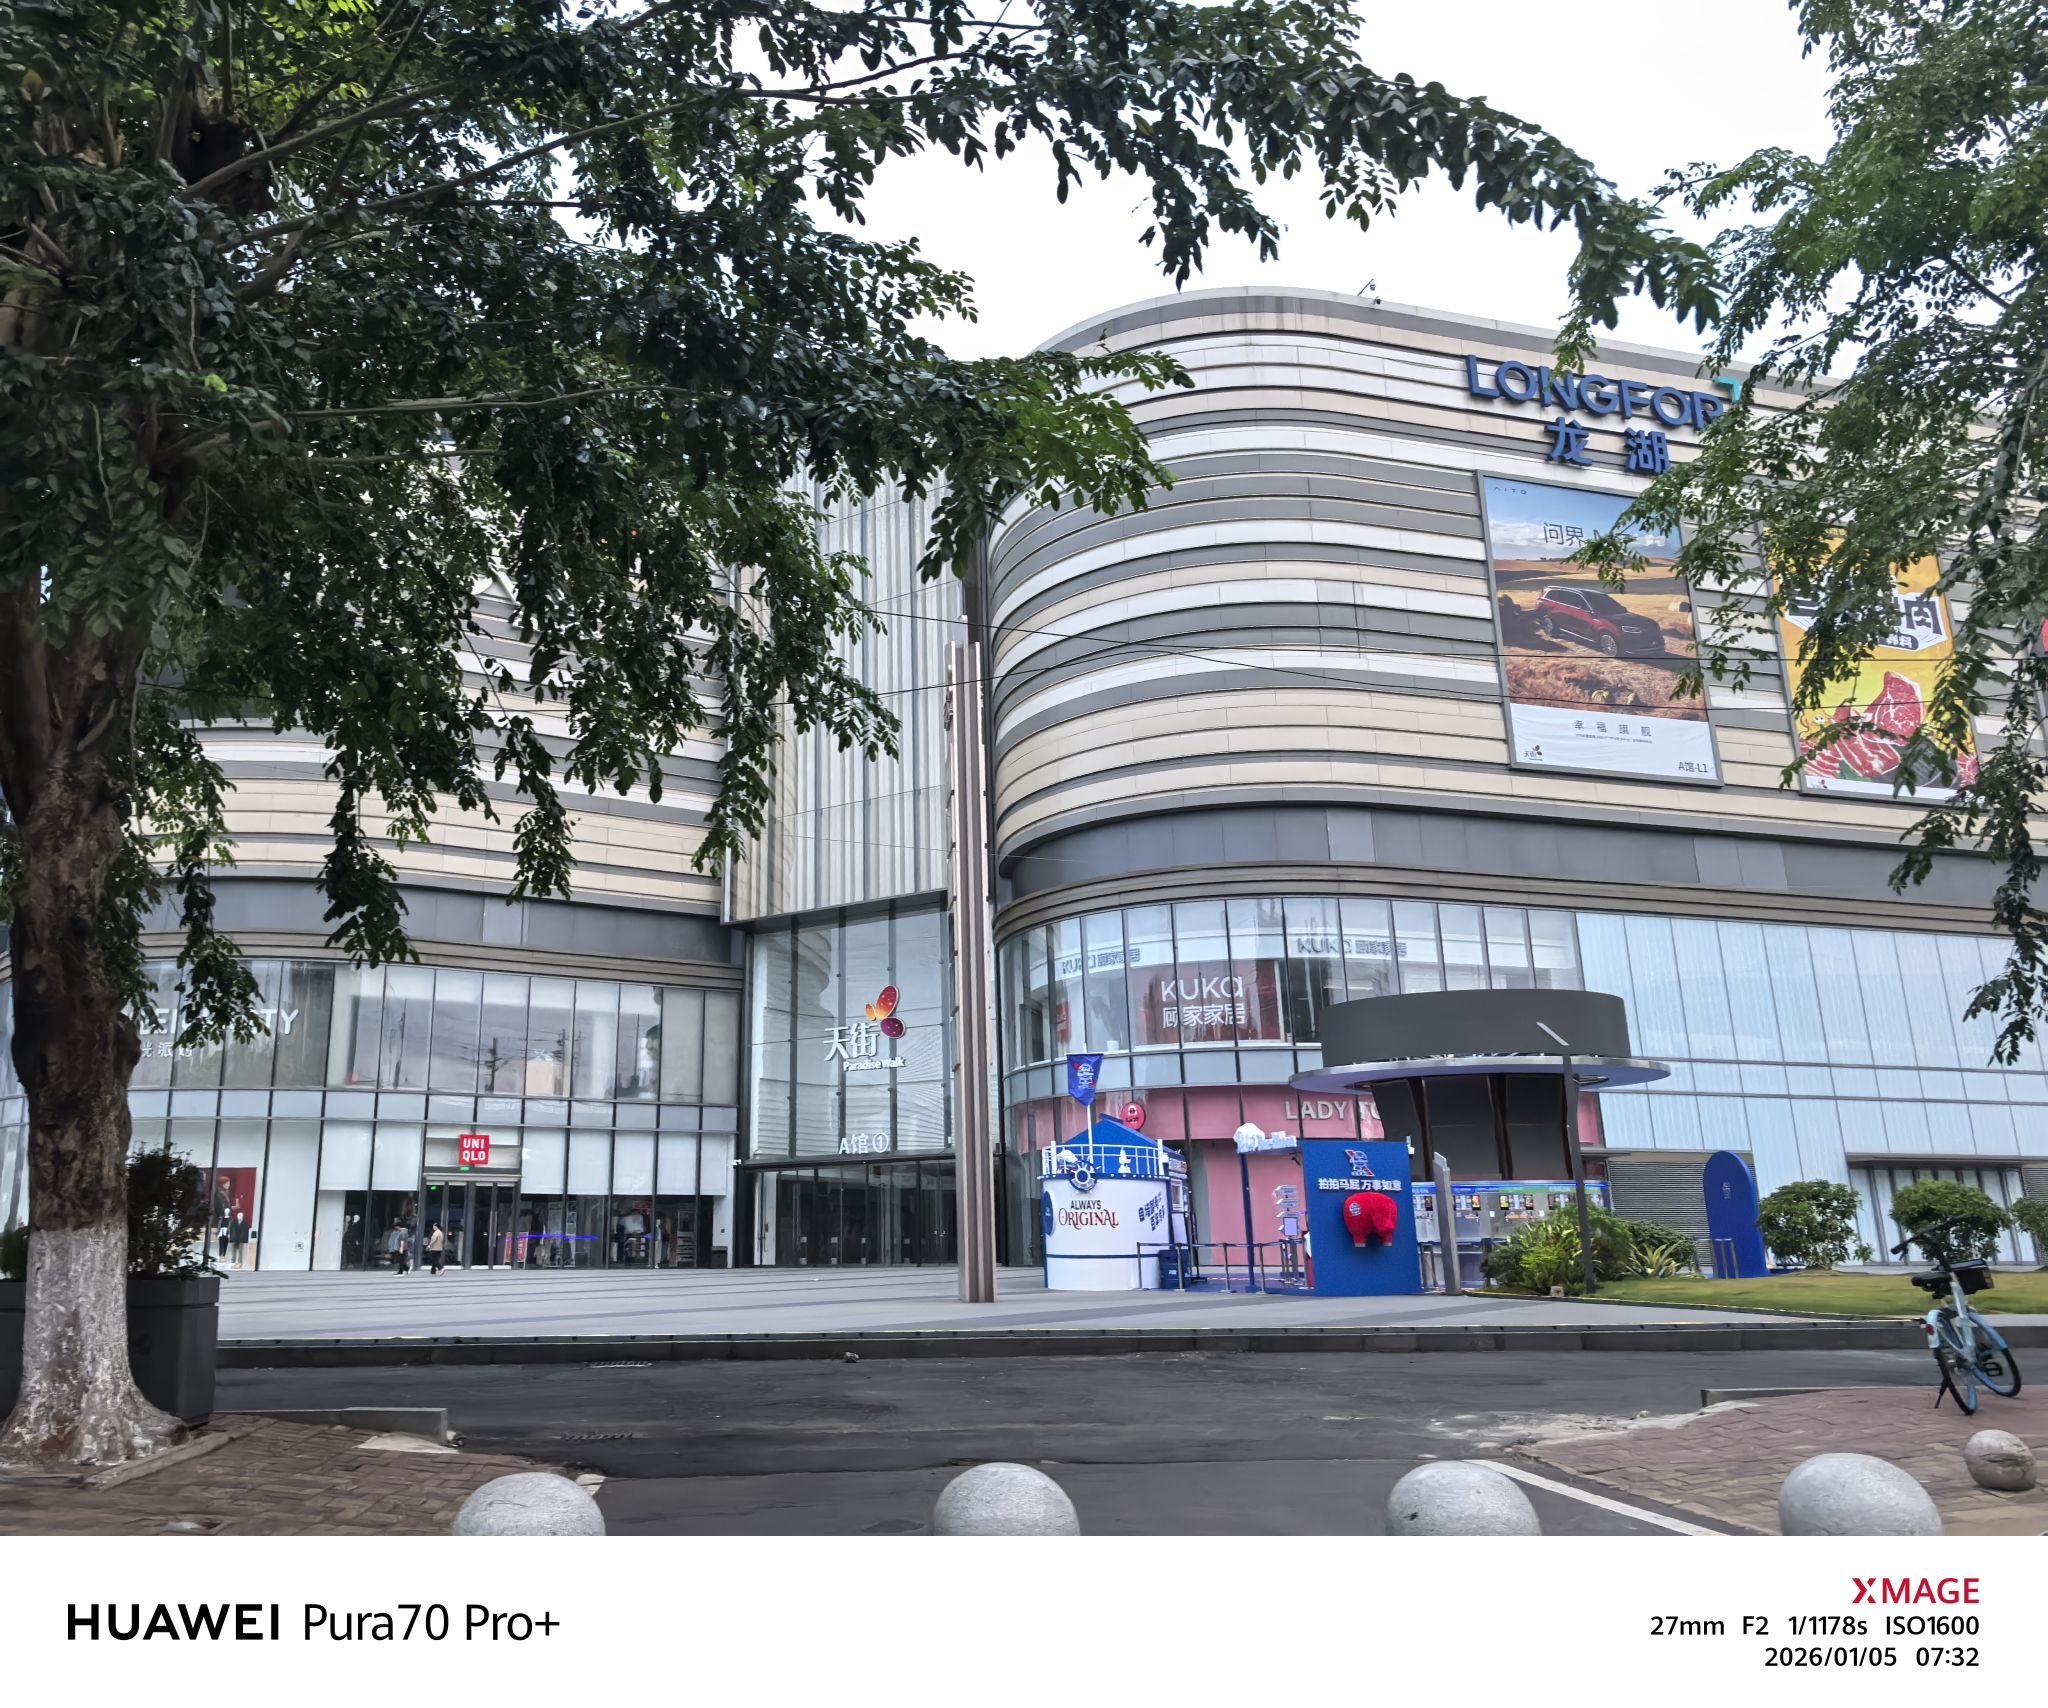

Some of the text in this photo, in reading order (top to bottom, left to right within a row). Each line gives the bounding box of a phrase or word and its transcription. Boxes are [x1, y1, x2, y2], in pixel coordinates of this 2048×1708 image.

[1465, 355, 1724, 431] LONGFOR
[1544, 416, 1670, 475] 龙湖
[1543, 523, 1584, 546] 问界
[1162, 1003, 1246, 1028] 顾家家居
[823, 1022, 880, 1061] 天街
[843, 1056, 906, 1071] Paradise Walk
[1285, 1100, 1347, 1120] LADY
[463, 1138, 484, 1149] UNI
[462, 1150, 486, 1162] QLO
[1070, 1200, 1102, 1211] ALWAYS
[1058, 1208, 1119, 1231] ORIGINAL
